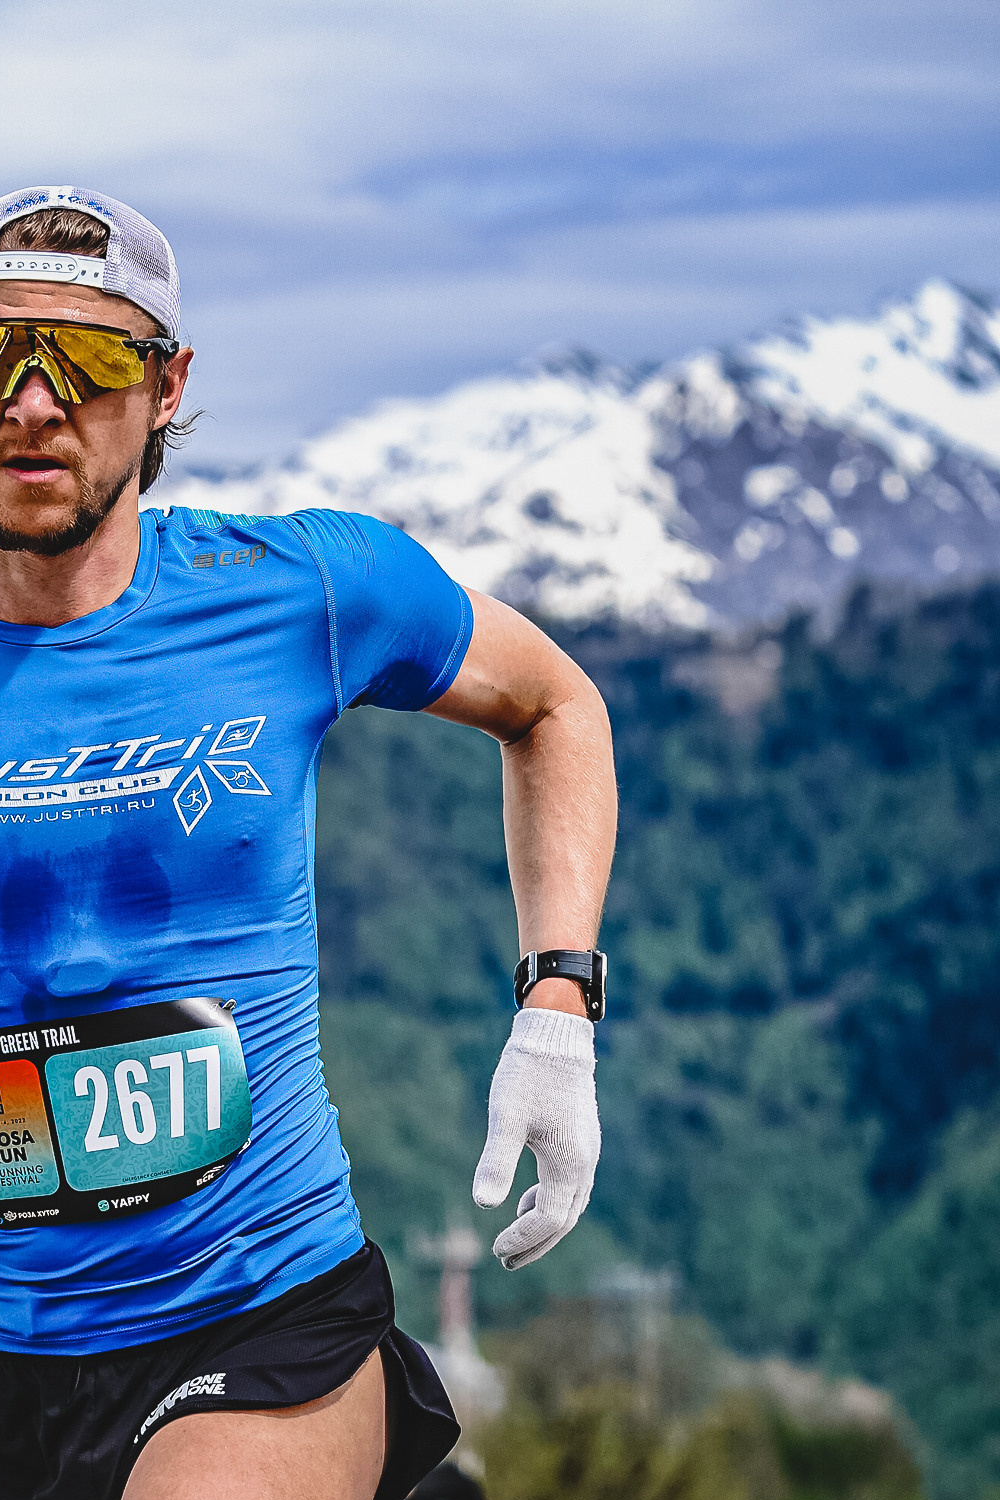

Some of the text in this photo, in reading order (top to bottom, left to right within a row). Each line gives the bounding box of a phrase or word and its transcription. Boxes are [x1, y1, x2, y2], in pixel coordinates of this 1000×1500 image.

[219, 543, 266, 567] cep
[79, 776, 161, 796] CLUB
[0, 1030, 40, 1055] GREEN
[41, 1025, 81, 1048] TRAIL
[73, 1044, 221, 1153] 2677
[111, 1192, 150, 1209] YAPPY
[190, 1373, 226, 1387] ONE
